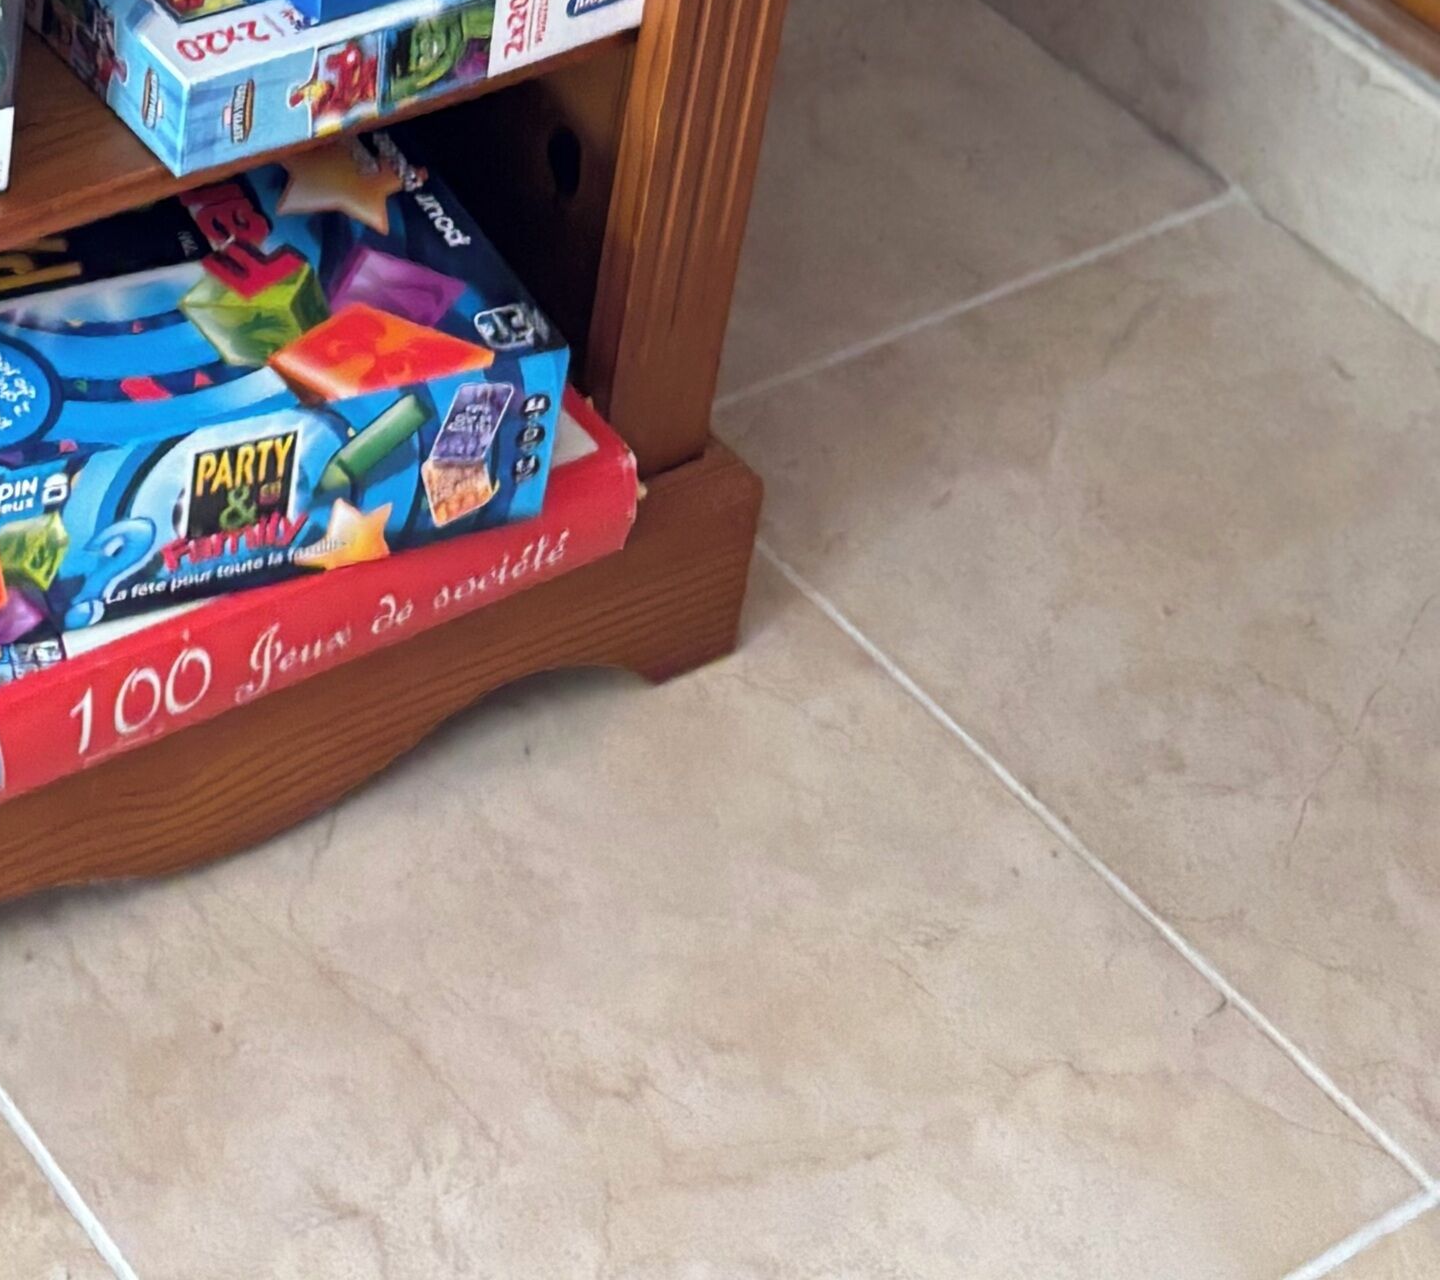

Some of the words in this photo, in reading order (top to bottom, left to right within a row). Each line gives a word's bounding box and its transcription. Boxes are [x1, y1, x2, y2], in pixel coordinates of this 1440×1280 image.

[176, 17, 271, 64] 2x20
[415, 192, 472, 248] pour
[195, 435, 294, 498] PARTY
[218, 488, 258, 531] &
[105, 586, 128, 605] La
[129, 579, 168, 601] fête
[169, 569, 212, 593] pour
[216, 557, 264, 579] toute
[267, 550, 285, 568] la
[70, 647, 213, 754] 100
[234, 622, 353, 703] Jeux
[371, 591, 416, 634] de
[432, 527, 571, 611] société
